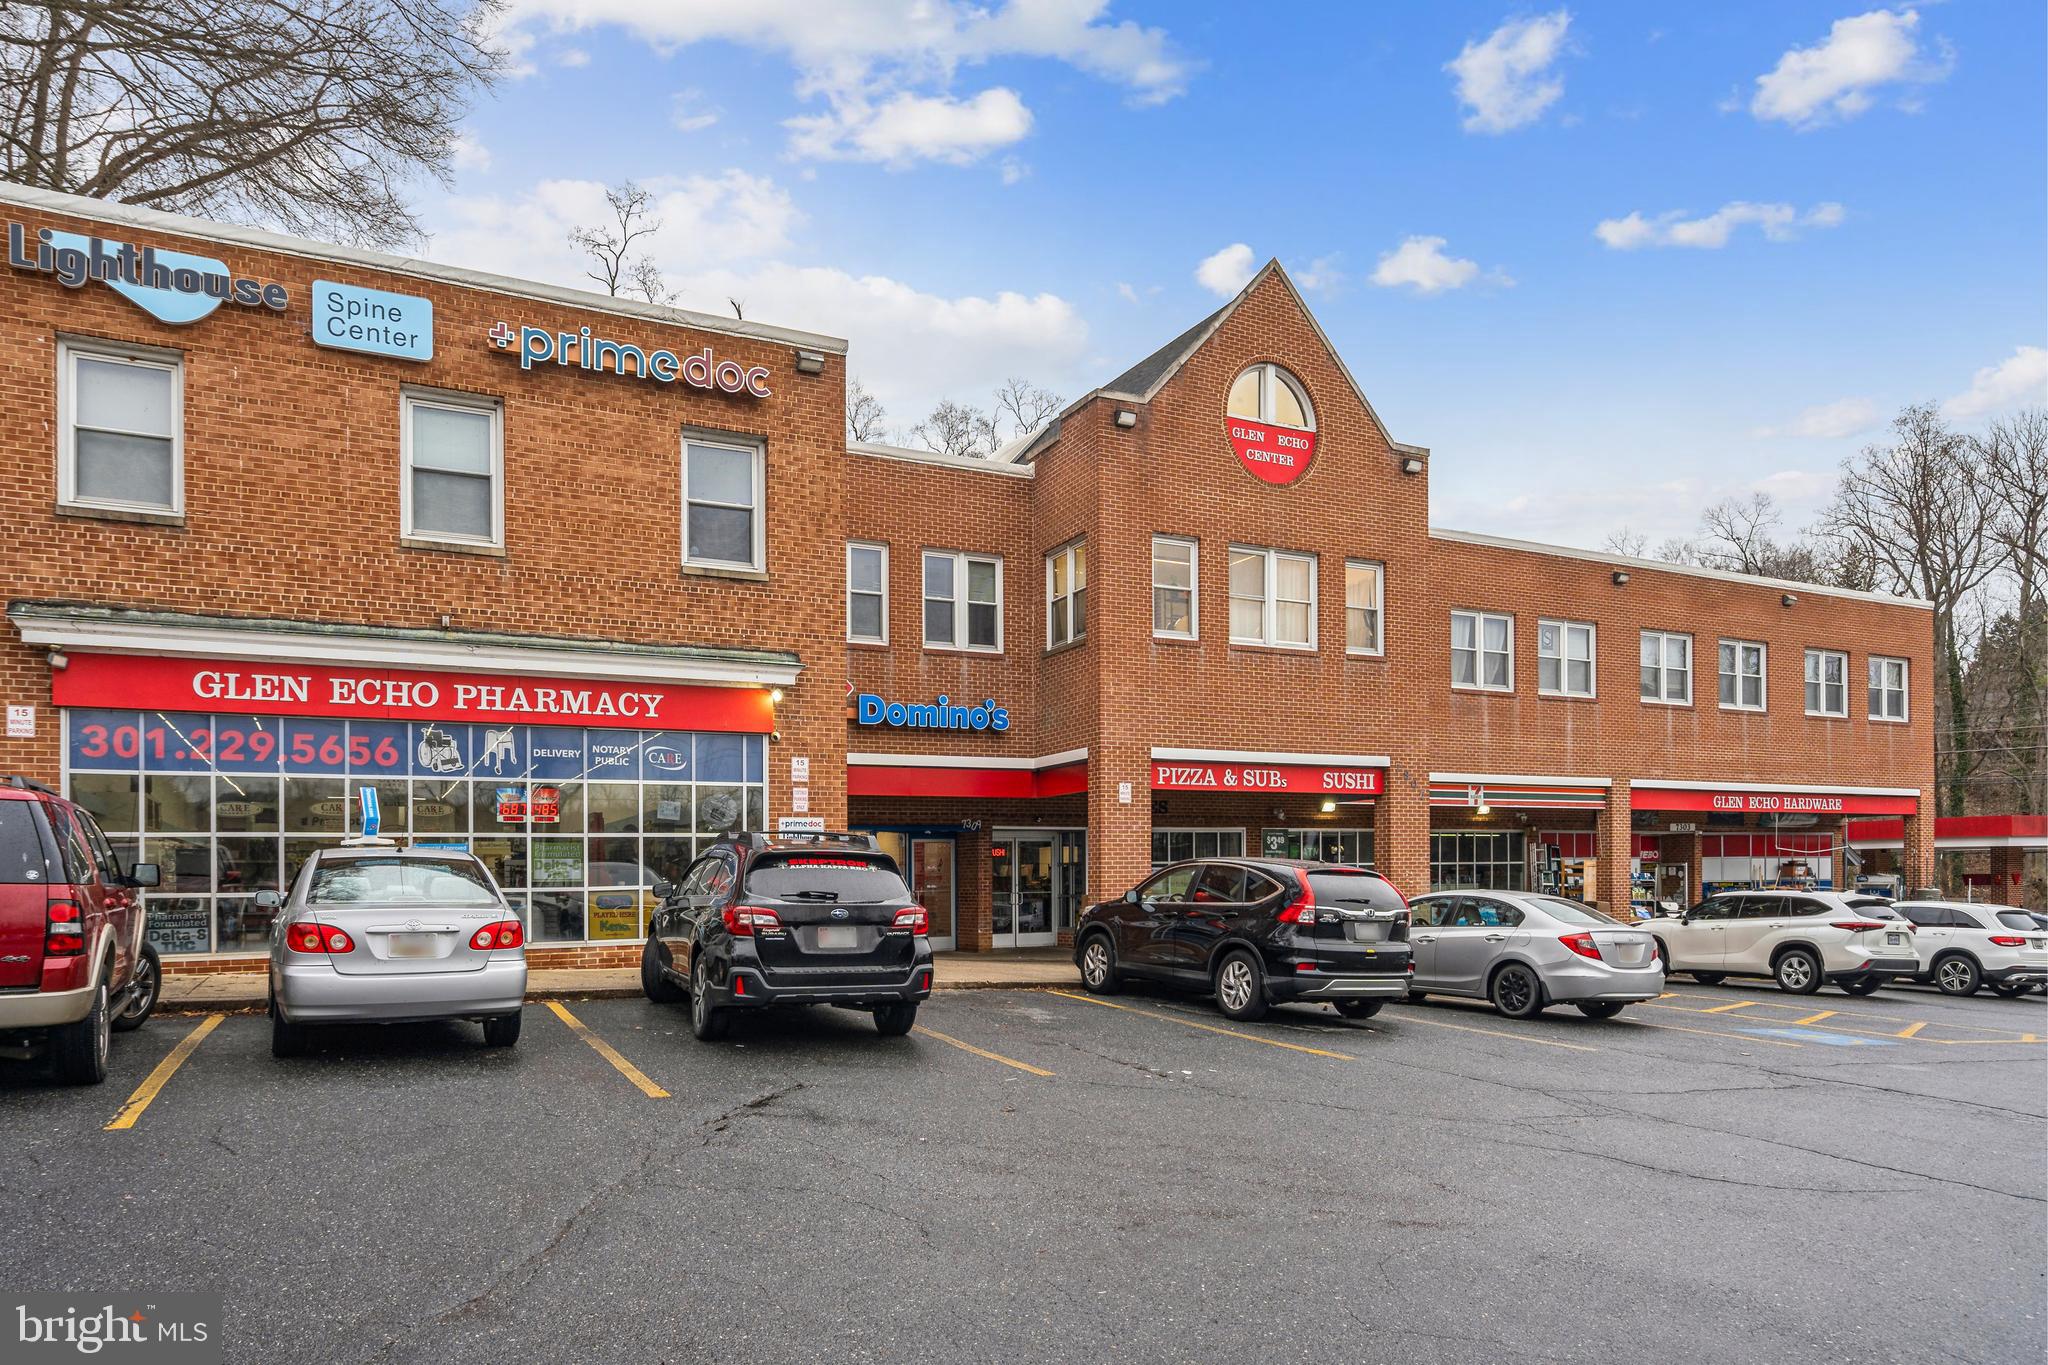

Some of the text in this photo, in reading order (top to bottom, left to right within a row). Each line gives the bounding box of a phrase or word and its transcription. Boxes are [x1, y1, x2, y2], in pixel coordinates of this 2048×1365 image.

[8, 222, 290, 311] Lighthouse
[327, 291, 402, 321] Spine
[327, 316, 419, 348] Center
[1232, 427, 1309, 449] GLEN ECHO
[1246, 448, 1295, 466] CENTER
[192, 671, 664, 718] GLEN ECHO PHARMACY
[14, 709, 29, 717] 15
[858, 693, 1010, 731] Domino's
[80, 724, 399, 767] 301.229.5656
[533, 747, 581, 760] DELIVERY
[592, 744, 632, 755] NOTARY
[595, 756, 629, 766] PUBLIC
[648, 752, 682, 766] CARE
[796, 759, 805, 767] 15
[1157, 767, 1217, 786] PIZZA
[1223, 769, 1238, 786] &
[1323, 772, 1375, 789] SUSHI
[1713, 795, 1842, 810] GLEN ECHO HARDWARE
